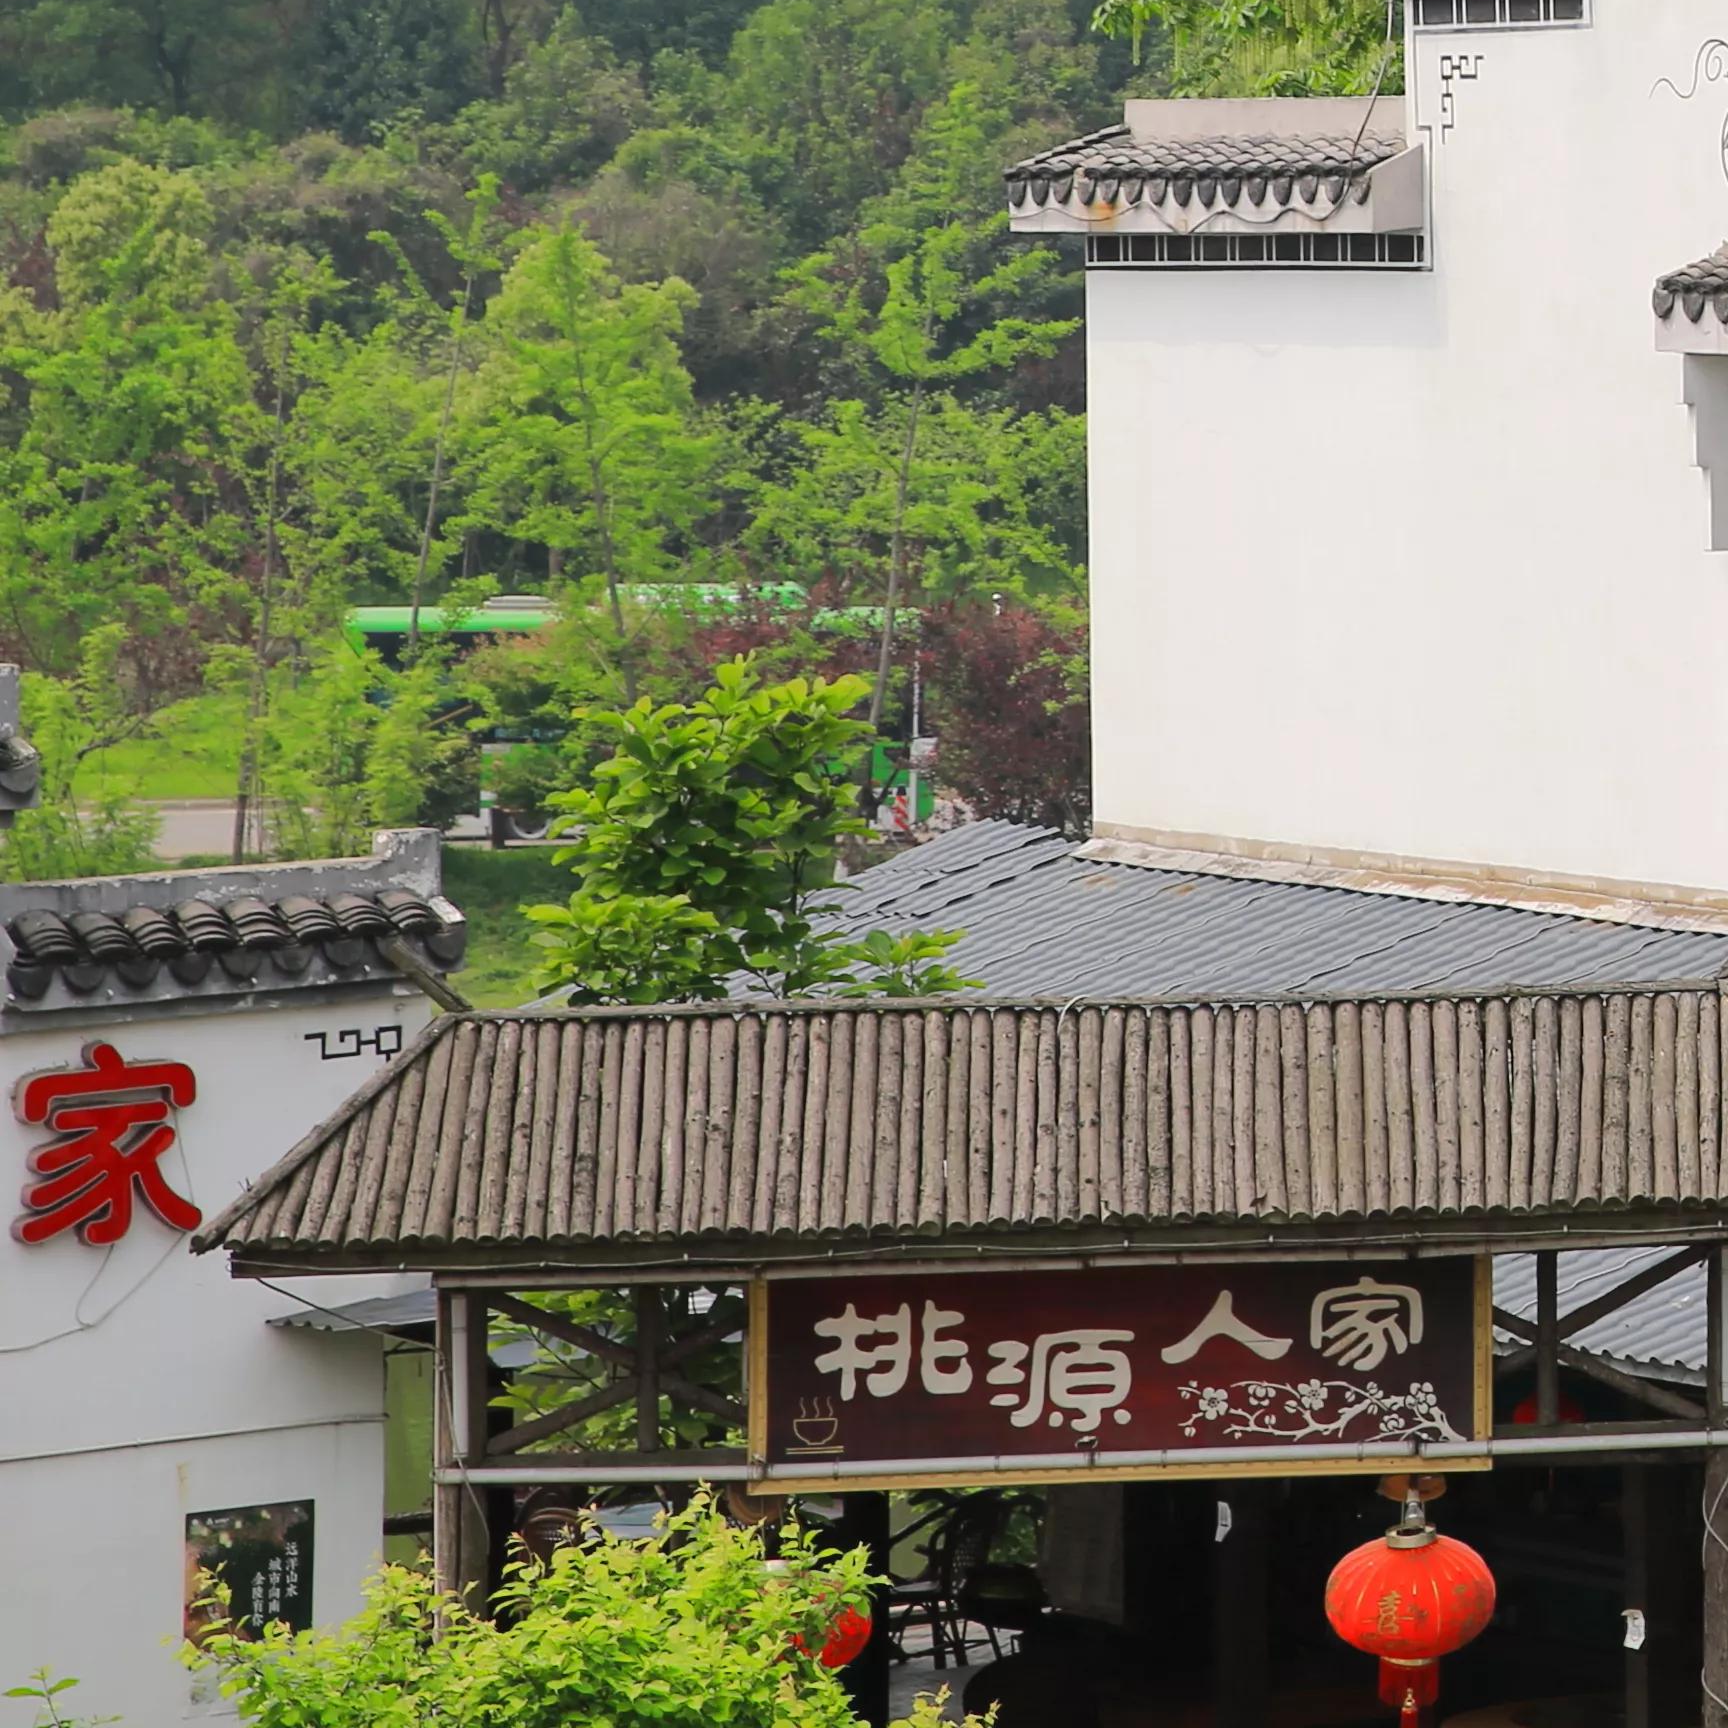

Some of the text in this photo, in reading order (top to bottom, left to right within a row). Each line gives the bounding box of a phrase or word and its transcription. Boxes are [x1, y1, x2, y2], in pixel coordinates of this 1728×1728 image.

[11, 1040, 203, 1244] 家
[814, 1276, 1423, 1432] 桃源人家
